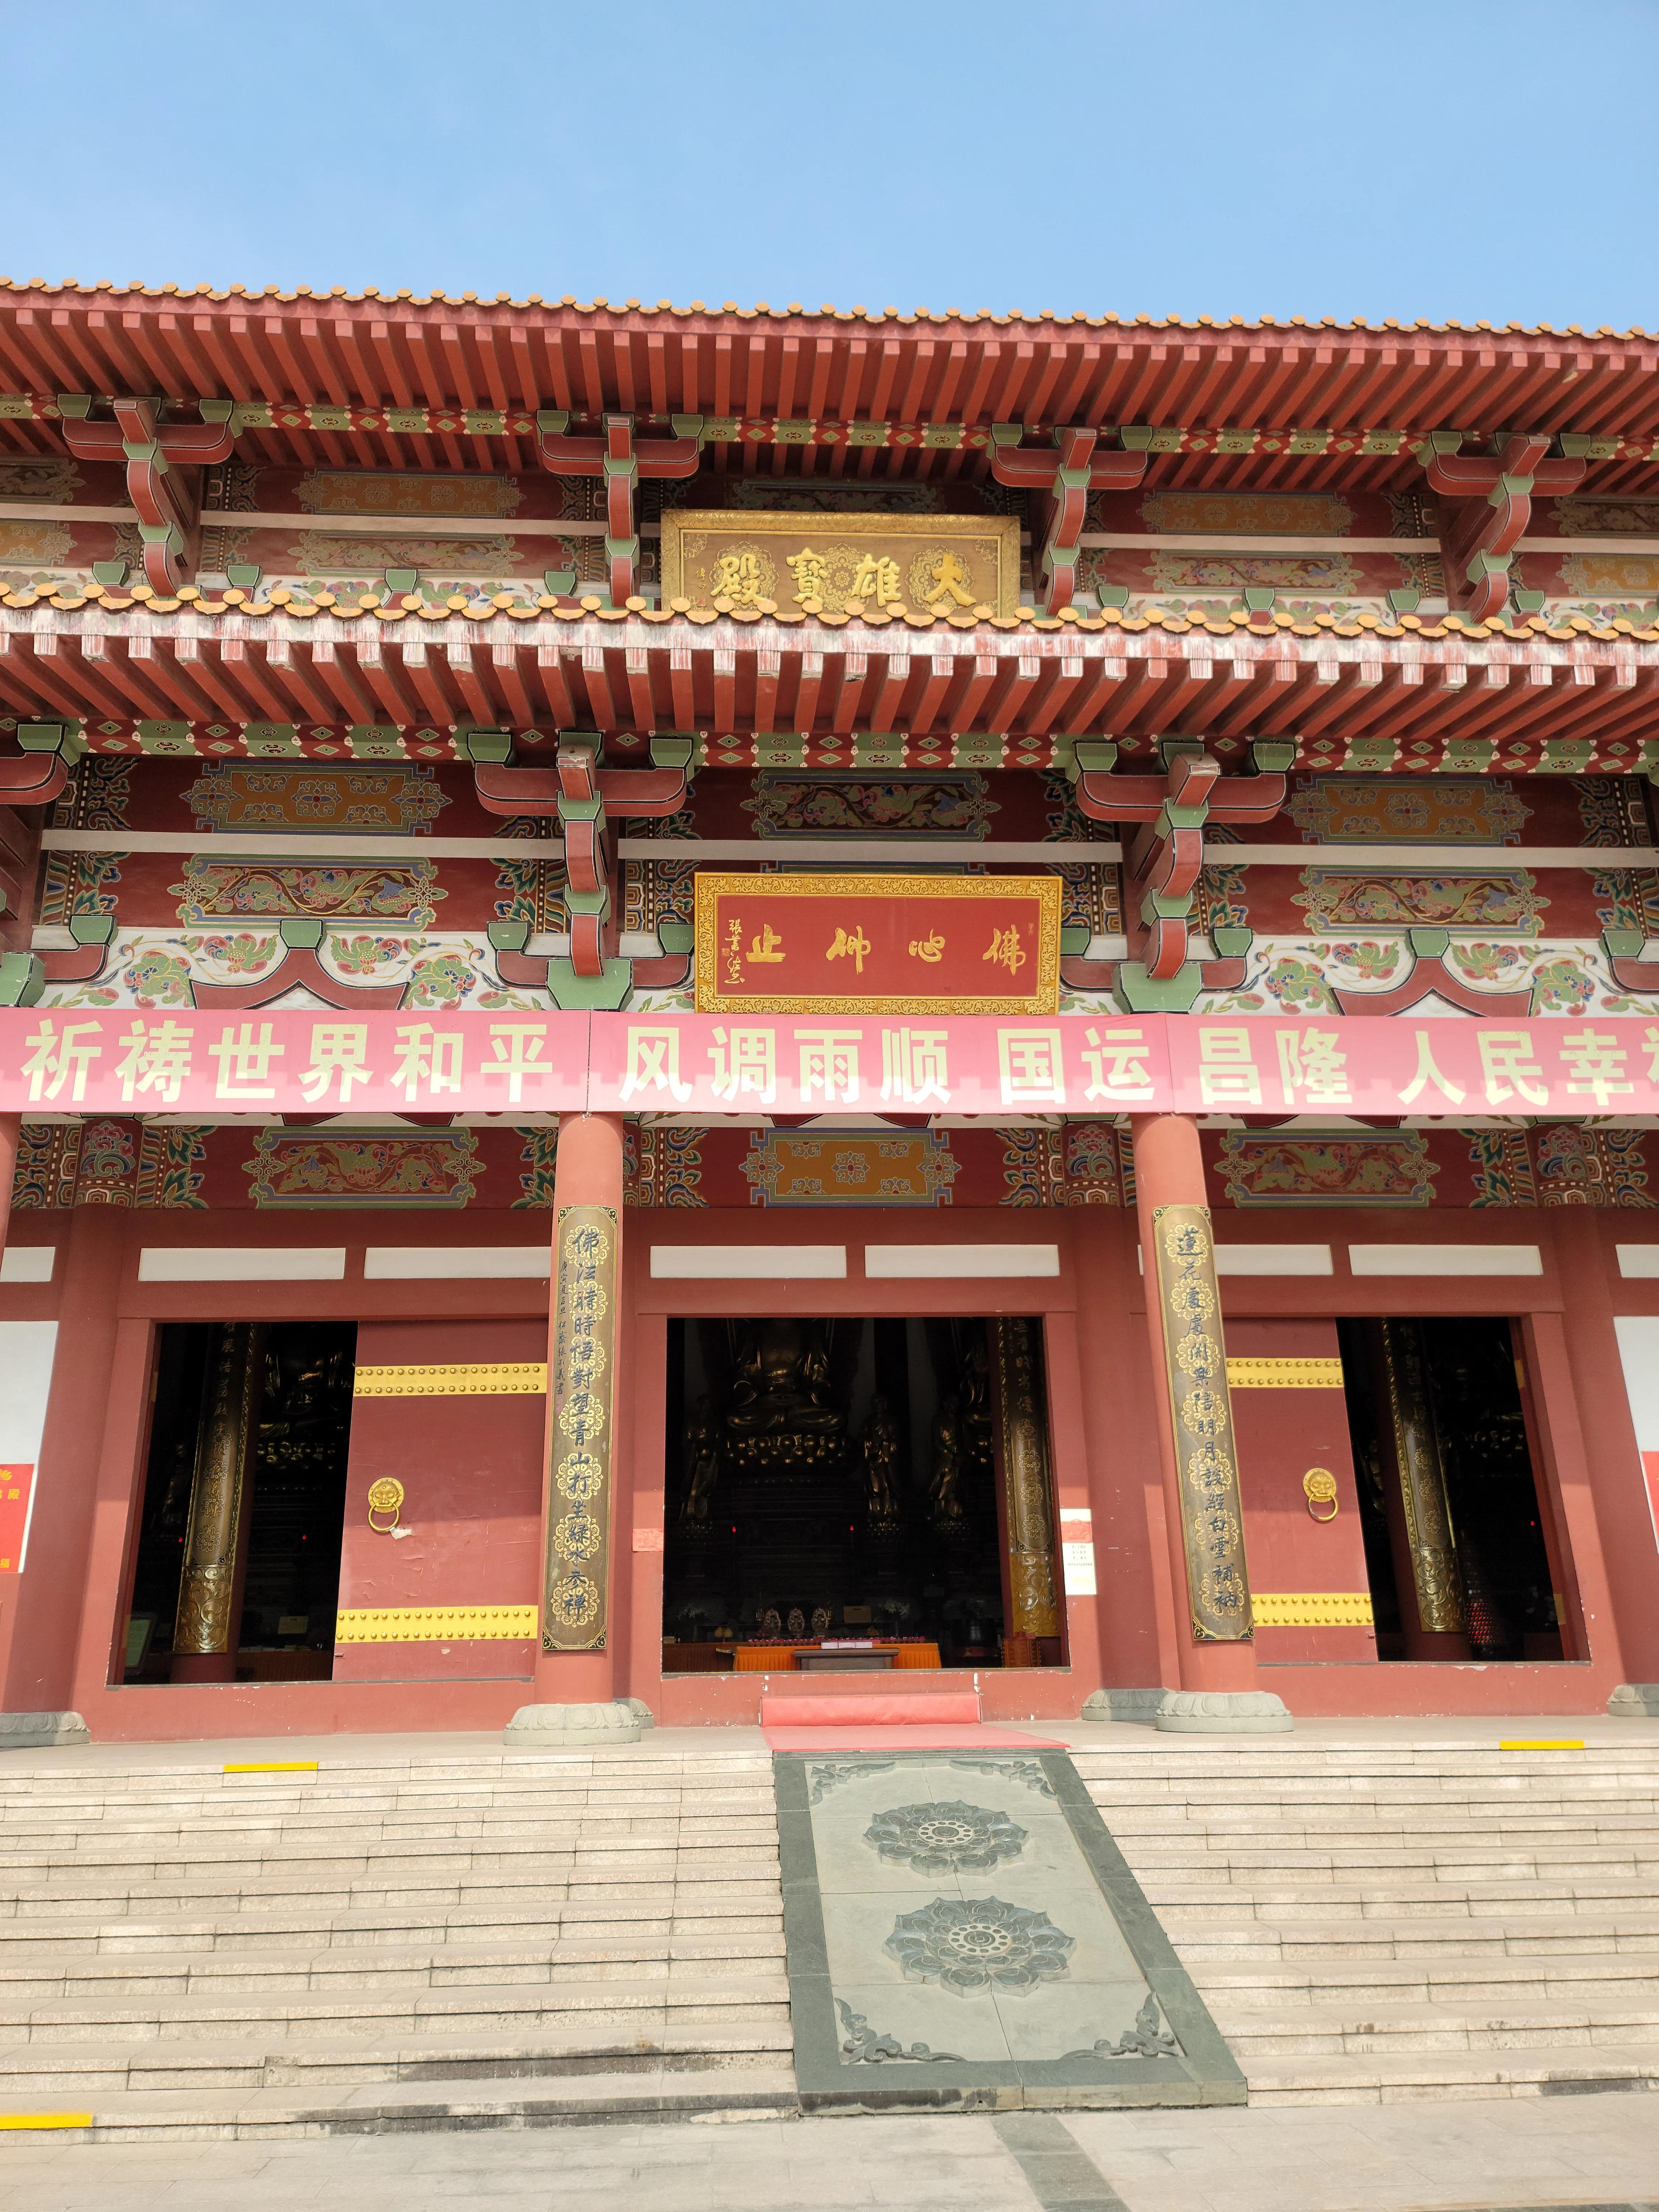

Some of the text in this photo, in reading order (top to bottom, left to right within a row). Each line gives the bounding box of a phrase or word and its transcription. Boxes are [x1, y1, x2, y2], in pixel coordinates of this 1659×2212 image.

[20, 1019, 553, 1103] 祈祷世界和平
[619, 1026, 951, 1105] 风调雨顺
[997, 1026, 1353, 1105] 国运昌隆
